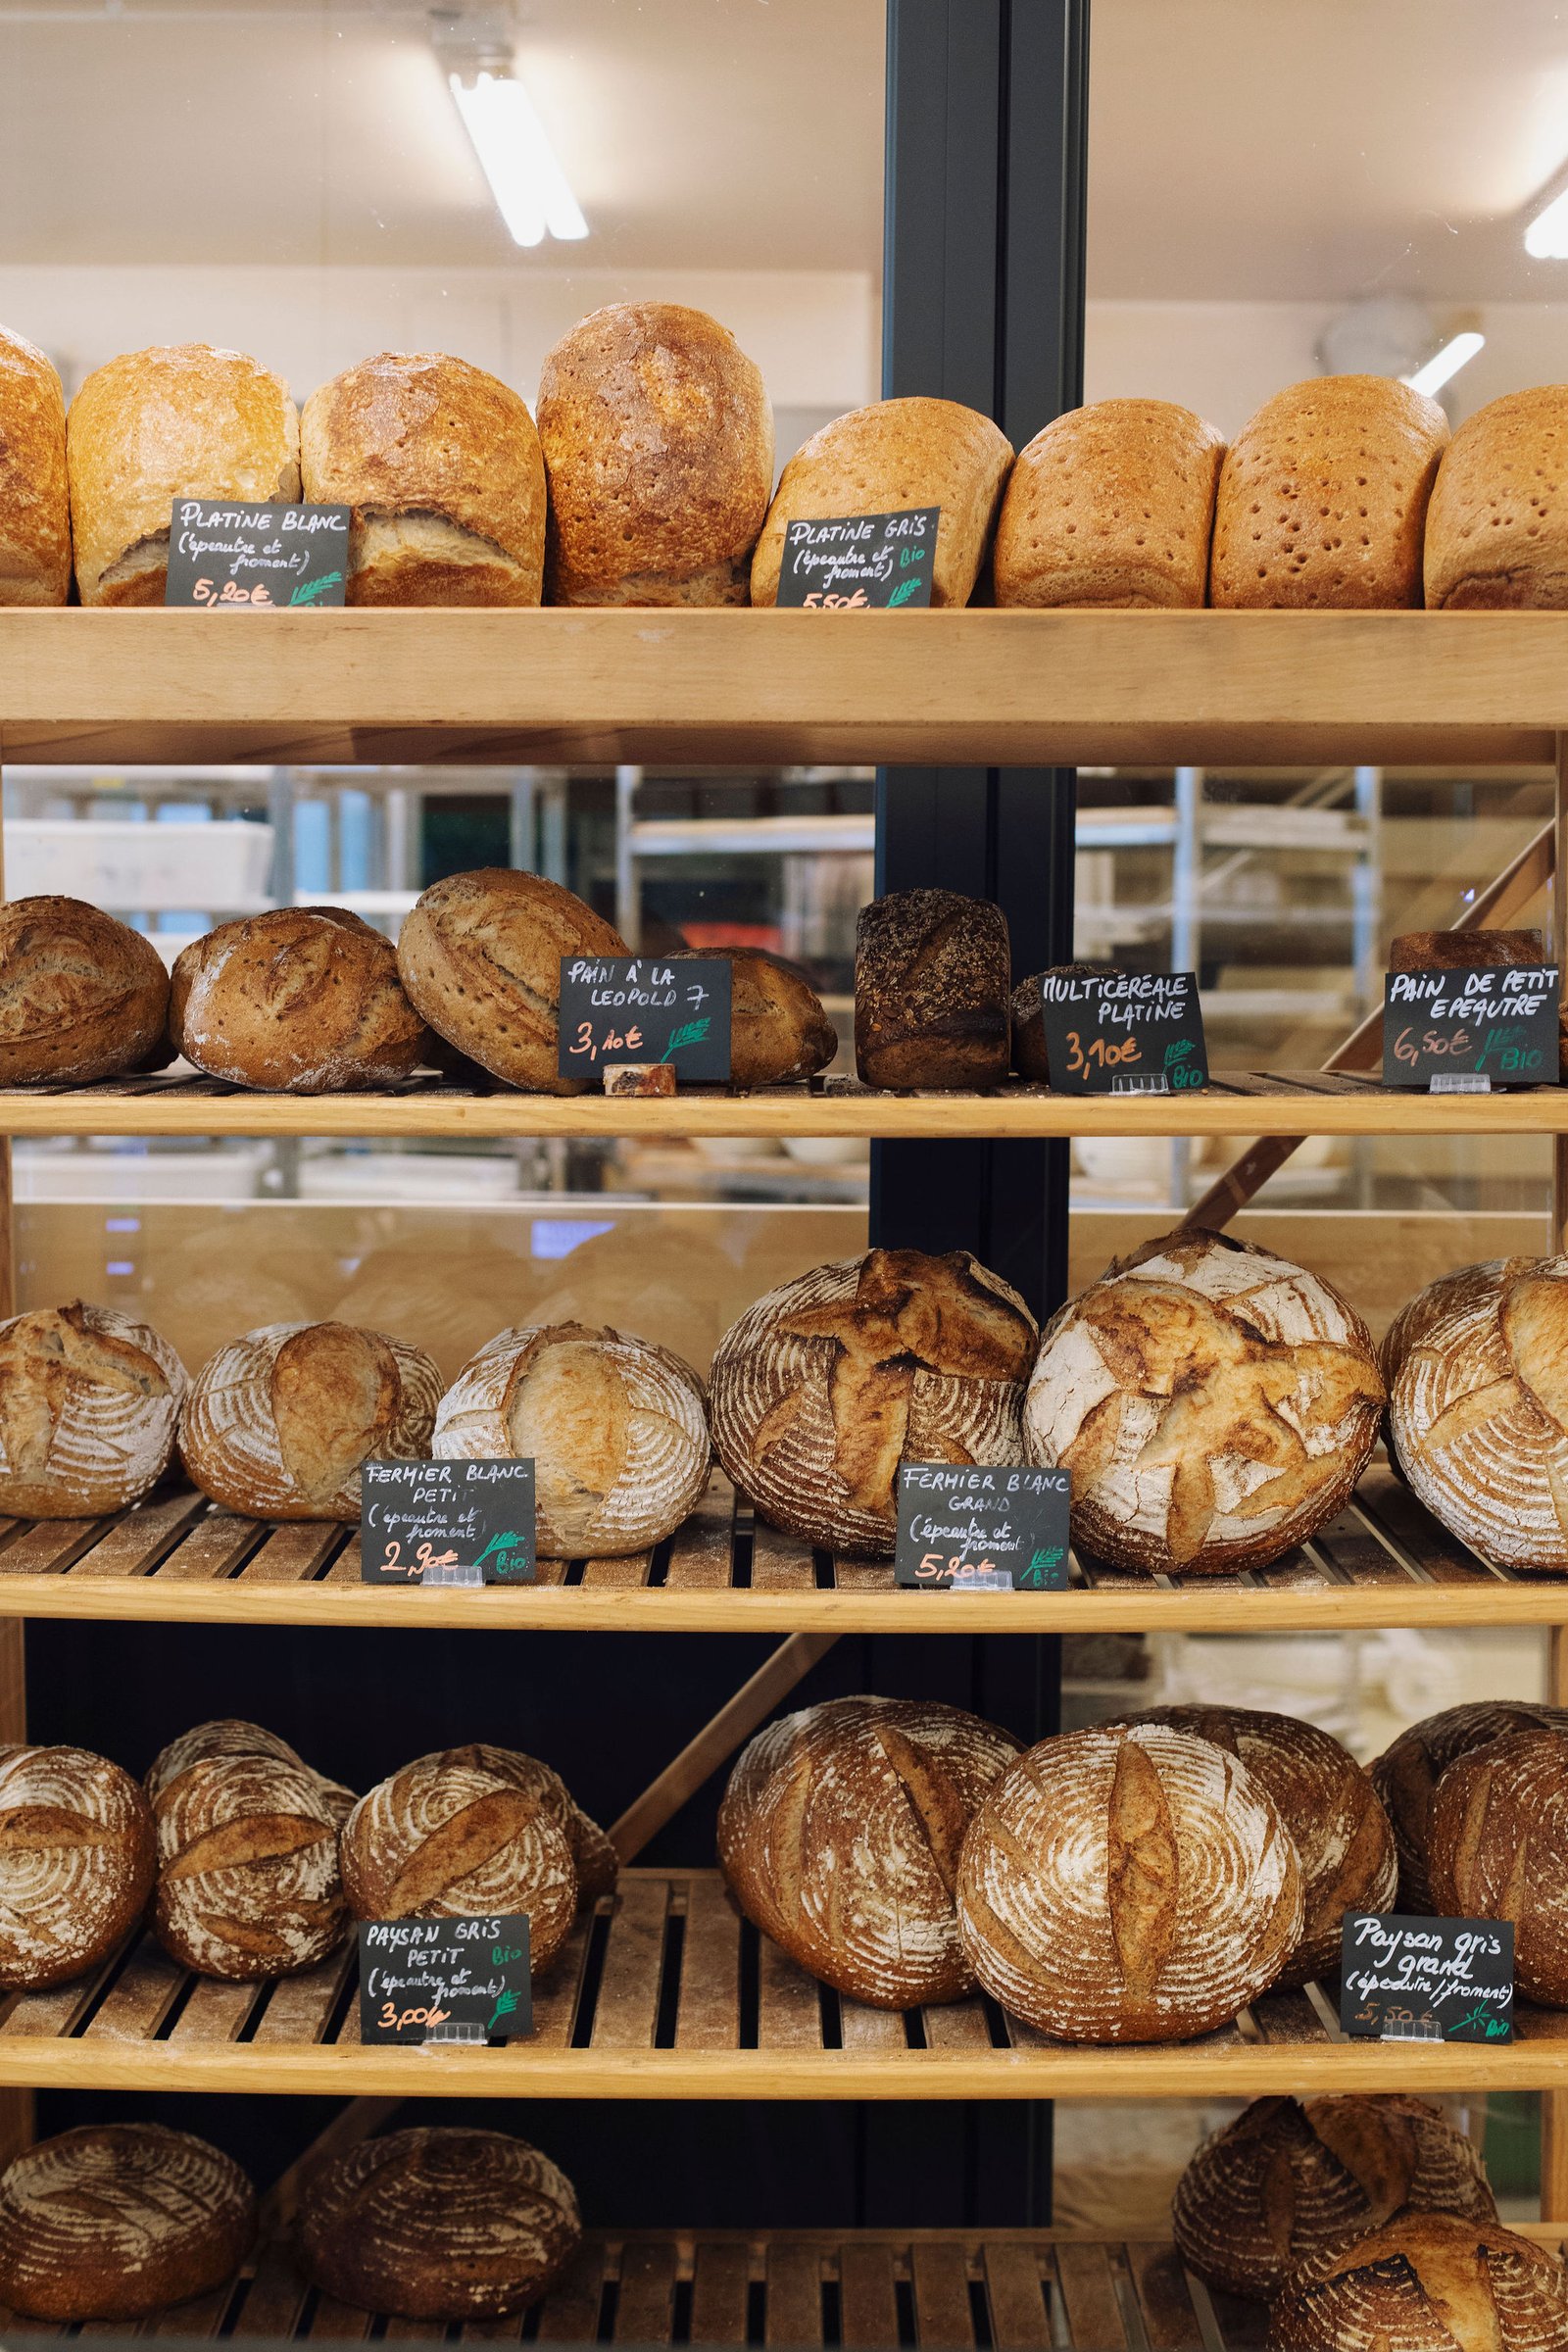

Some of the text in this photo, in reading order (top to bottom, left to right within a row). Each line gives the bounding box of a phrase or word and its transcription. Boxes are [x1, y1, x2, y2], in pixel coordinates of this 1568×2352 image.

[281, 511, 347, 533] BLANC
[263, 539, 282, 554] et
[872, 545, 894, 561] et
[651, 967, 675, 985] LA
[1464, 973, 1495, 996] DE
[591, 985, 710, 1010] LEOPOLD 7
[1431, 994, 1547, 1027] EPEAUTRE
[1066, 1031, 1143, 1080] 3,10€
[1394, 1027, 1472, 1067] 6,50€
[1006, 1474, 1070, 1495] BLANC
[949, 1495, 1010, 1511] GRAND
[459, 1507, 482, 1523] et
[993, 1521, 1011, 1539] et
[367, 1925, 439, 1953] PAYSAN
[1354, 1918, 1501, 1968] Paysan gris
[451, 1968, 472, 1984] et
[1397, 1954, 1474, 1982] grand
